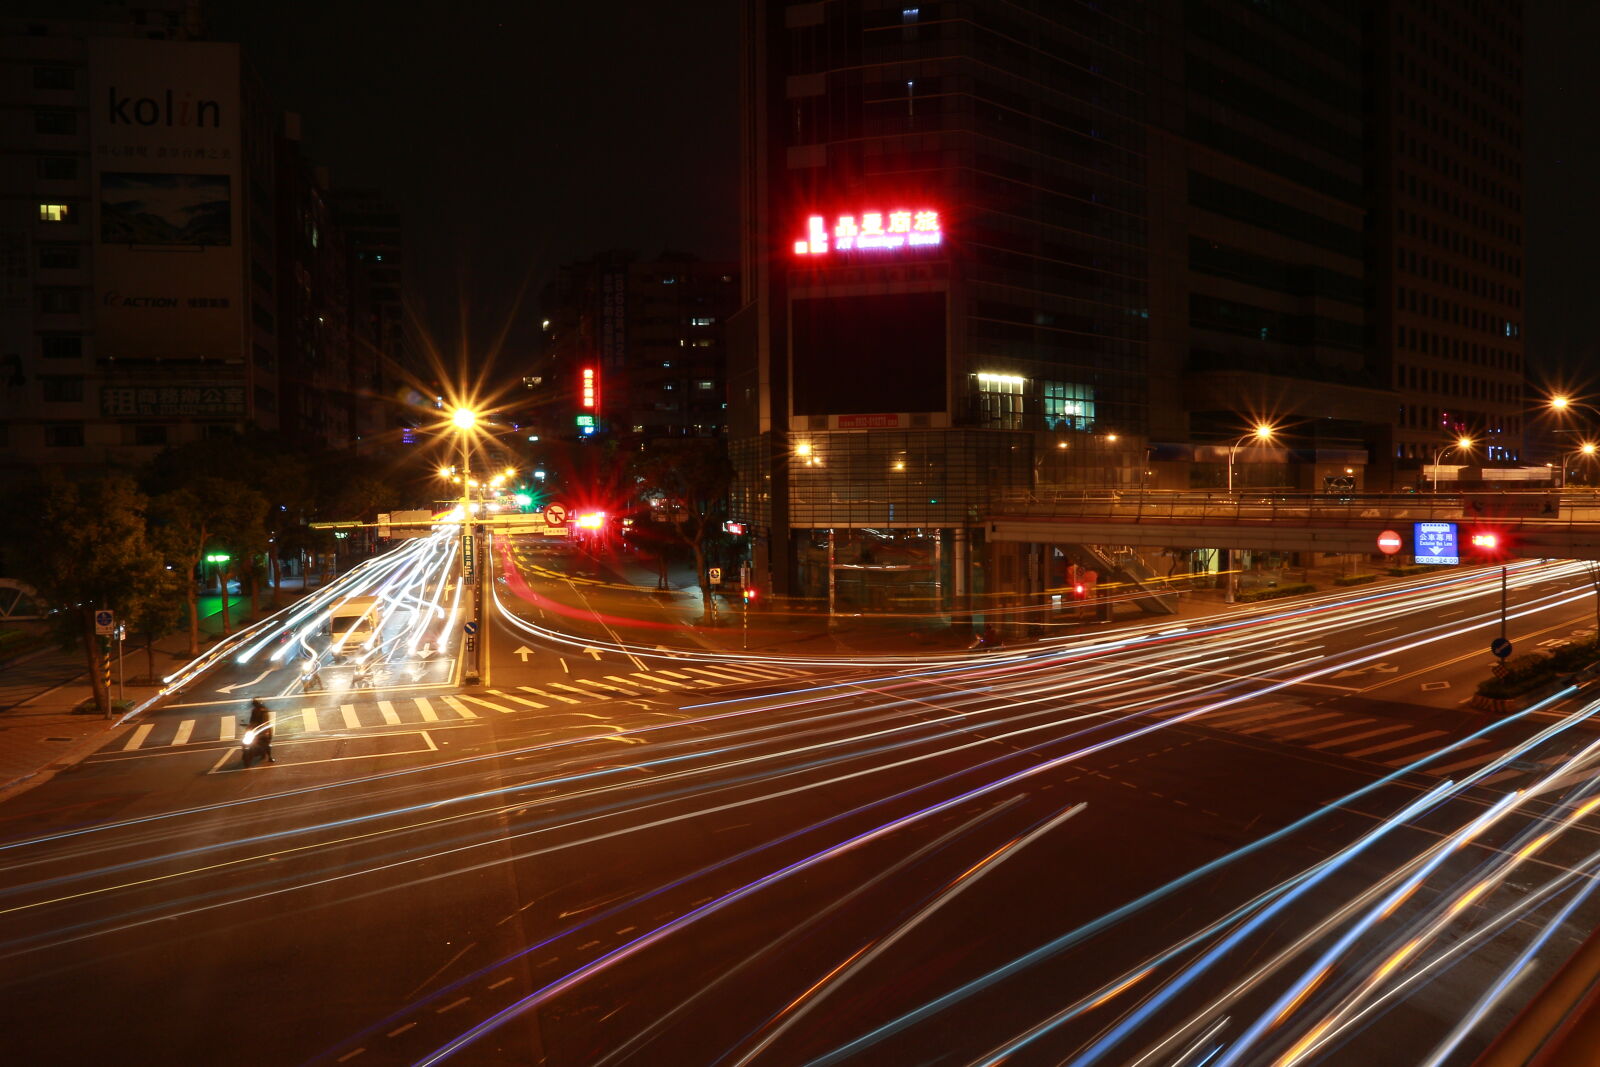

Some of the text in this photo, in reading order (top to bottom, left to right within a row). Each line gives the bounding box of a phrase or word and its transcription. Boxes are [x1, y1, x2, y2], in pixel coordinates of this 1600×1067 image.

[109, 86, 220, 128] kolin
[122, 297, 178, 308] ACTION
[104, 388, 138, 416] 租
[1419, 533, 1453, 541] 公車專用
